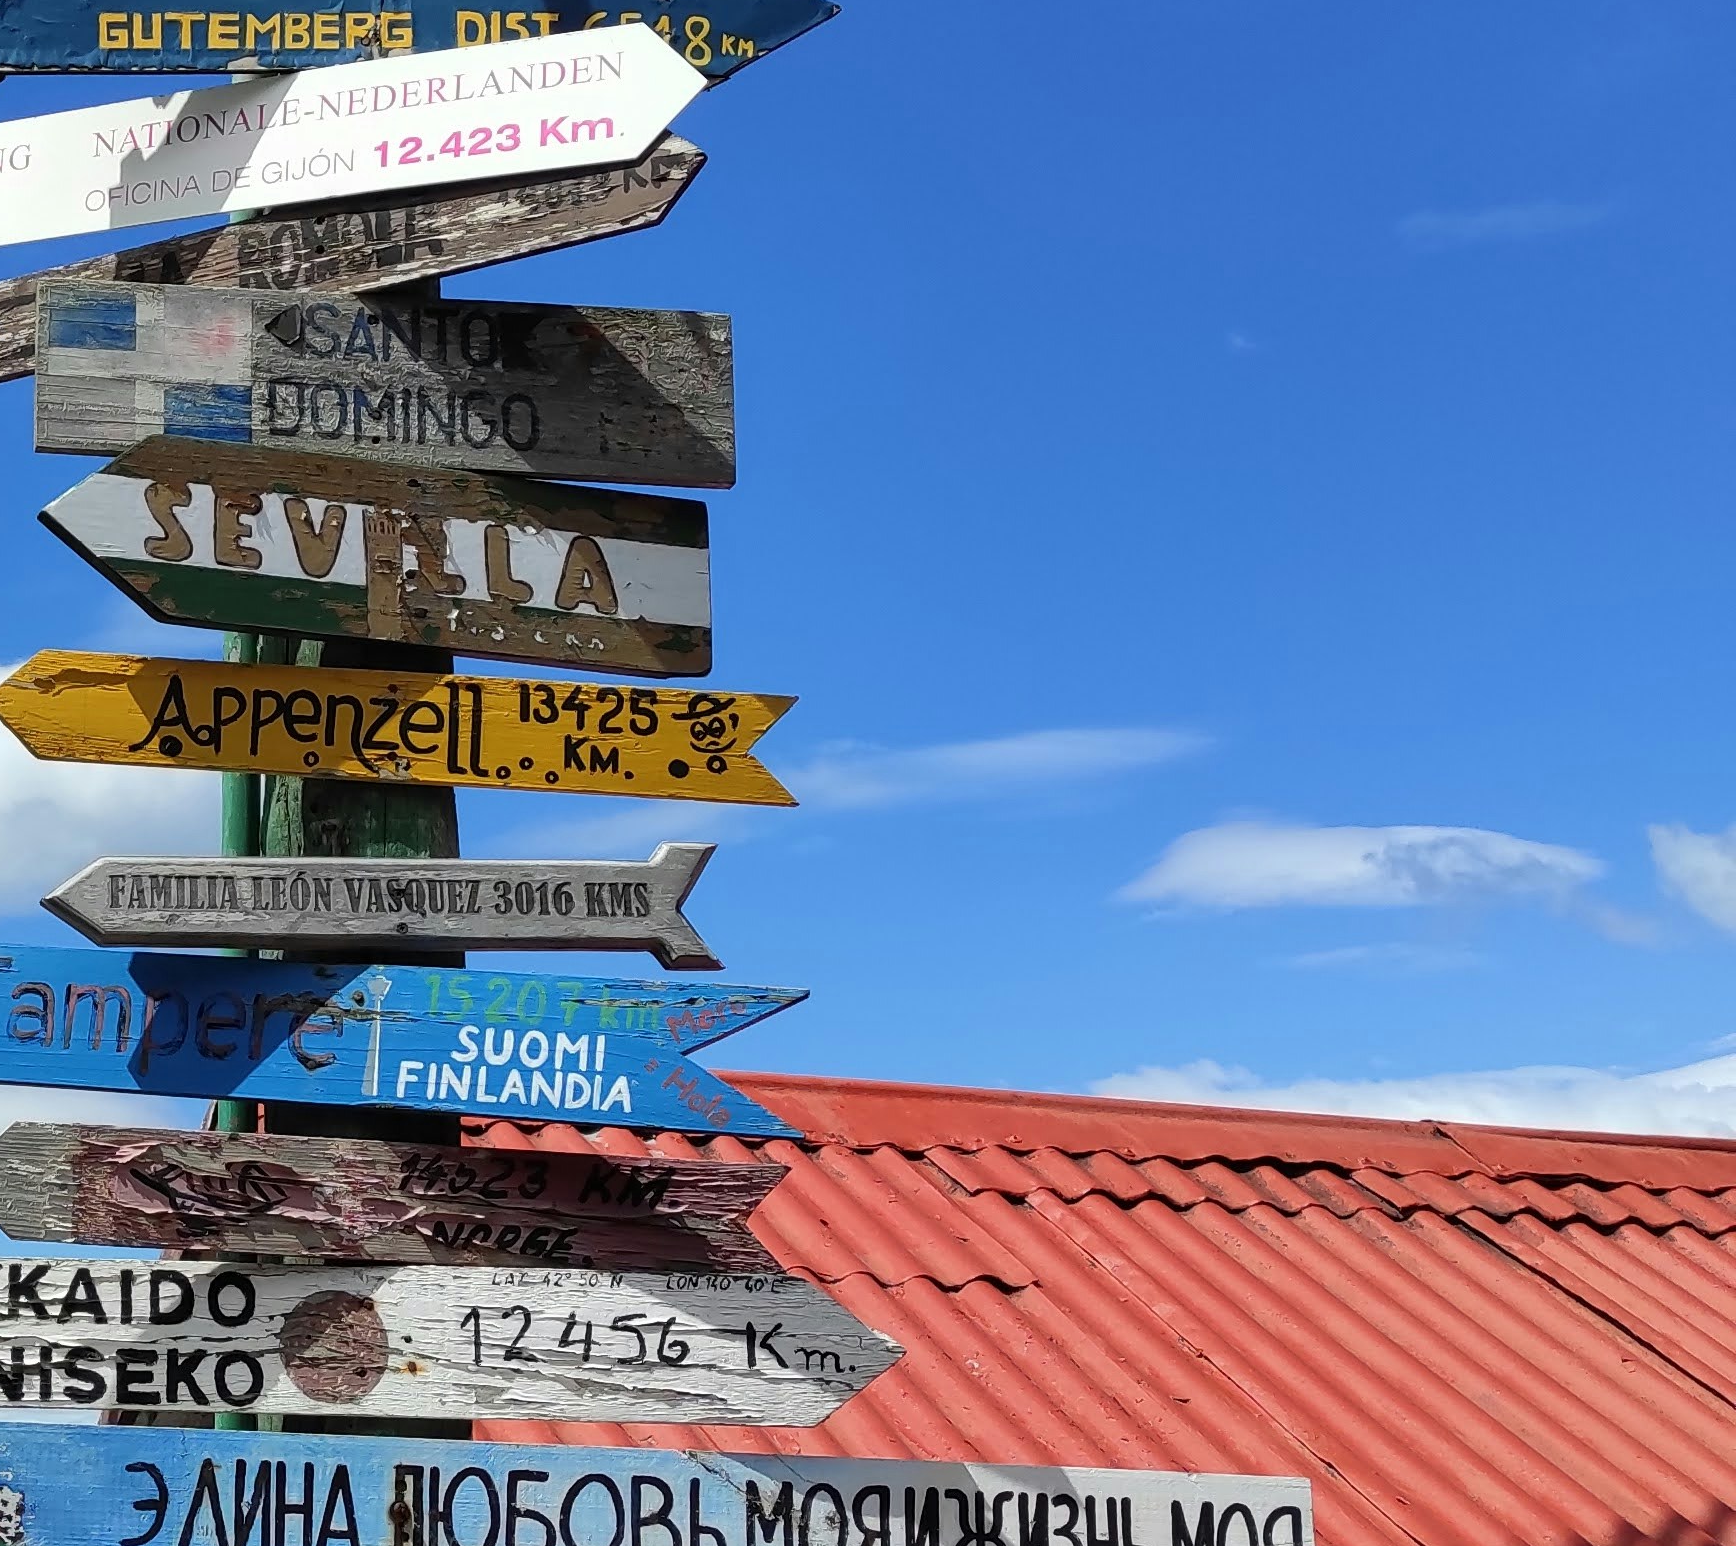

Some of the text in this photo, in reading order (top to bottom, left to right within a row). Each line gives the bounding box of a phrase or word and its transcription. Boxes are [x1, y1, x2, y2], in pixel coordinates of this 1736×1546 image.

[98, 11, 413, 52] GUTEMBERG
[91, 50, 627, 160] NATIONALE-NEDERLANDEN
[83, 176, 202, 213] OFICINA
[211, 166, 252, 191] DE
[260, 148, 355, 185] GIJÓN
[373, 124, 522, 169] 12.423
[303, 301, 499, 371] SANTO
[265, 378, 541, 453] DOMINGO
[144, 482, 619, 639] SEVILLA
[518, 683, 659, 736] 13425
[562, 737, 634, 780] KM.
[108, 870, 650, 918] FAMILIA LEÓN VASQUEZ 3016 KMS
[599, 985, 660, 1030] km
[450, 1025, 605, 1072] SUOMI
[396, 1060, 632, 1114] FINLANDIA
